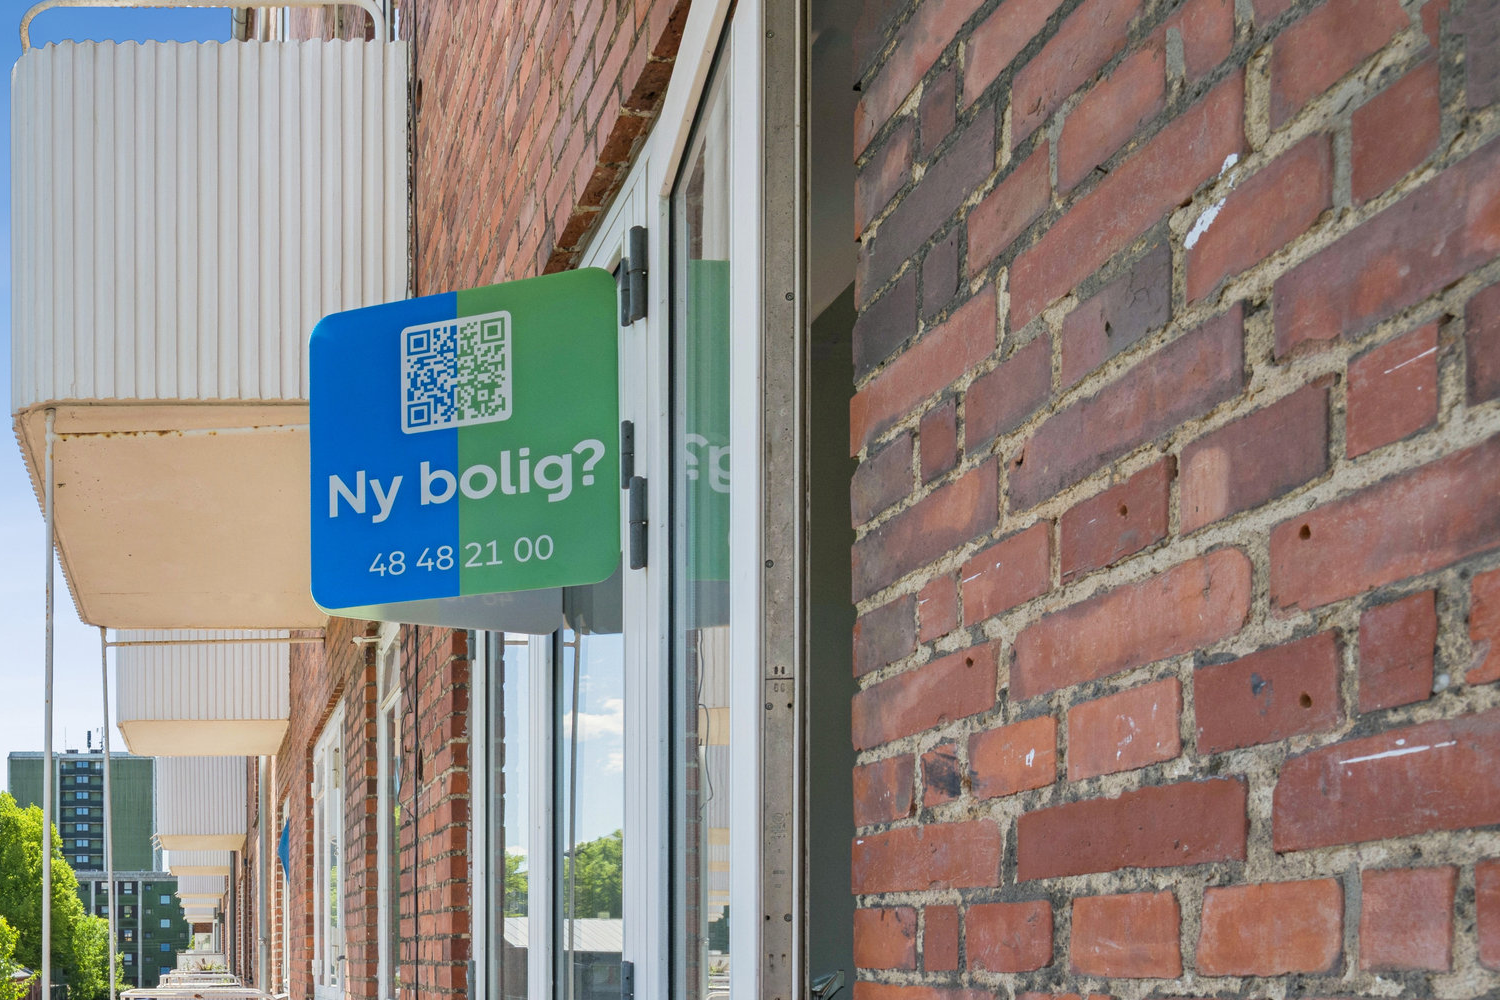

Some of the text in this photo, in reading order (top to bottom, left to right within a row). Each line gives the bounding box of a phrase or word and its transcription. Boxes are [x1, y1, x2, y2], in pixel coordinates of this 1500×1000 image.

[329, 438, 606, 523] Ny bolig?
[369, 534, 554, 576] 48 48 21 00
